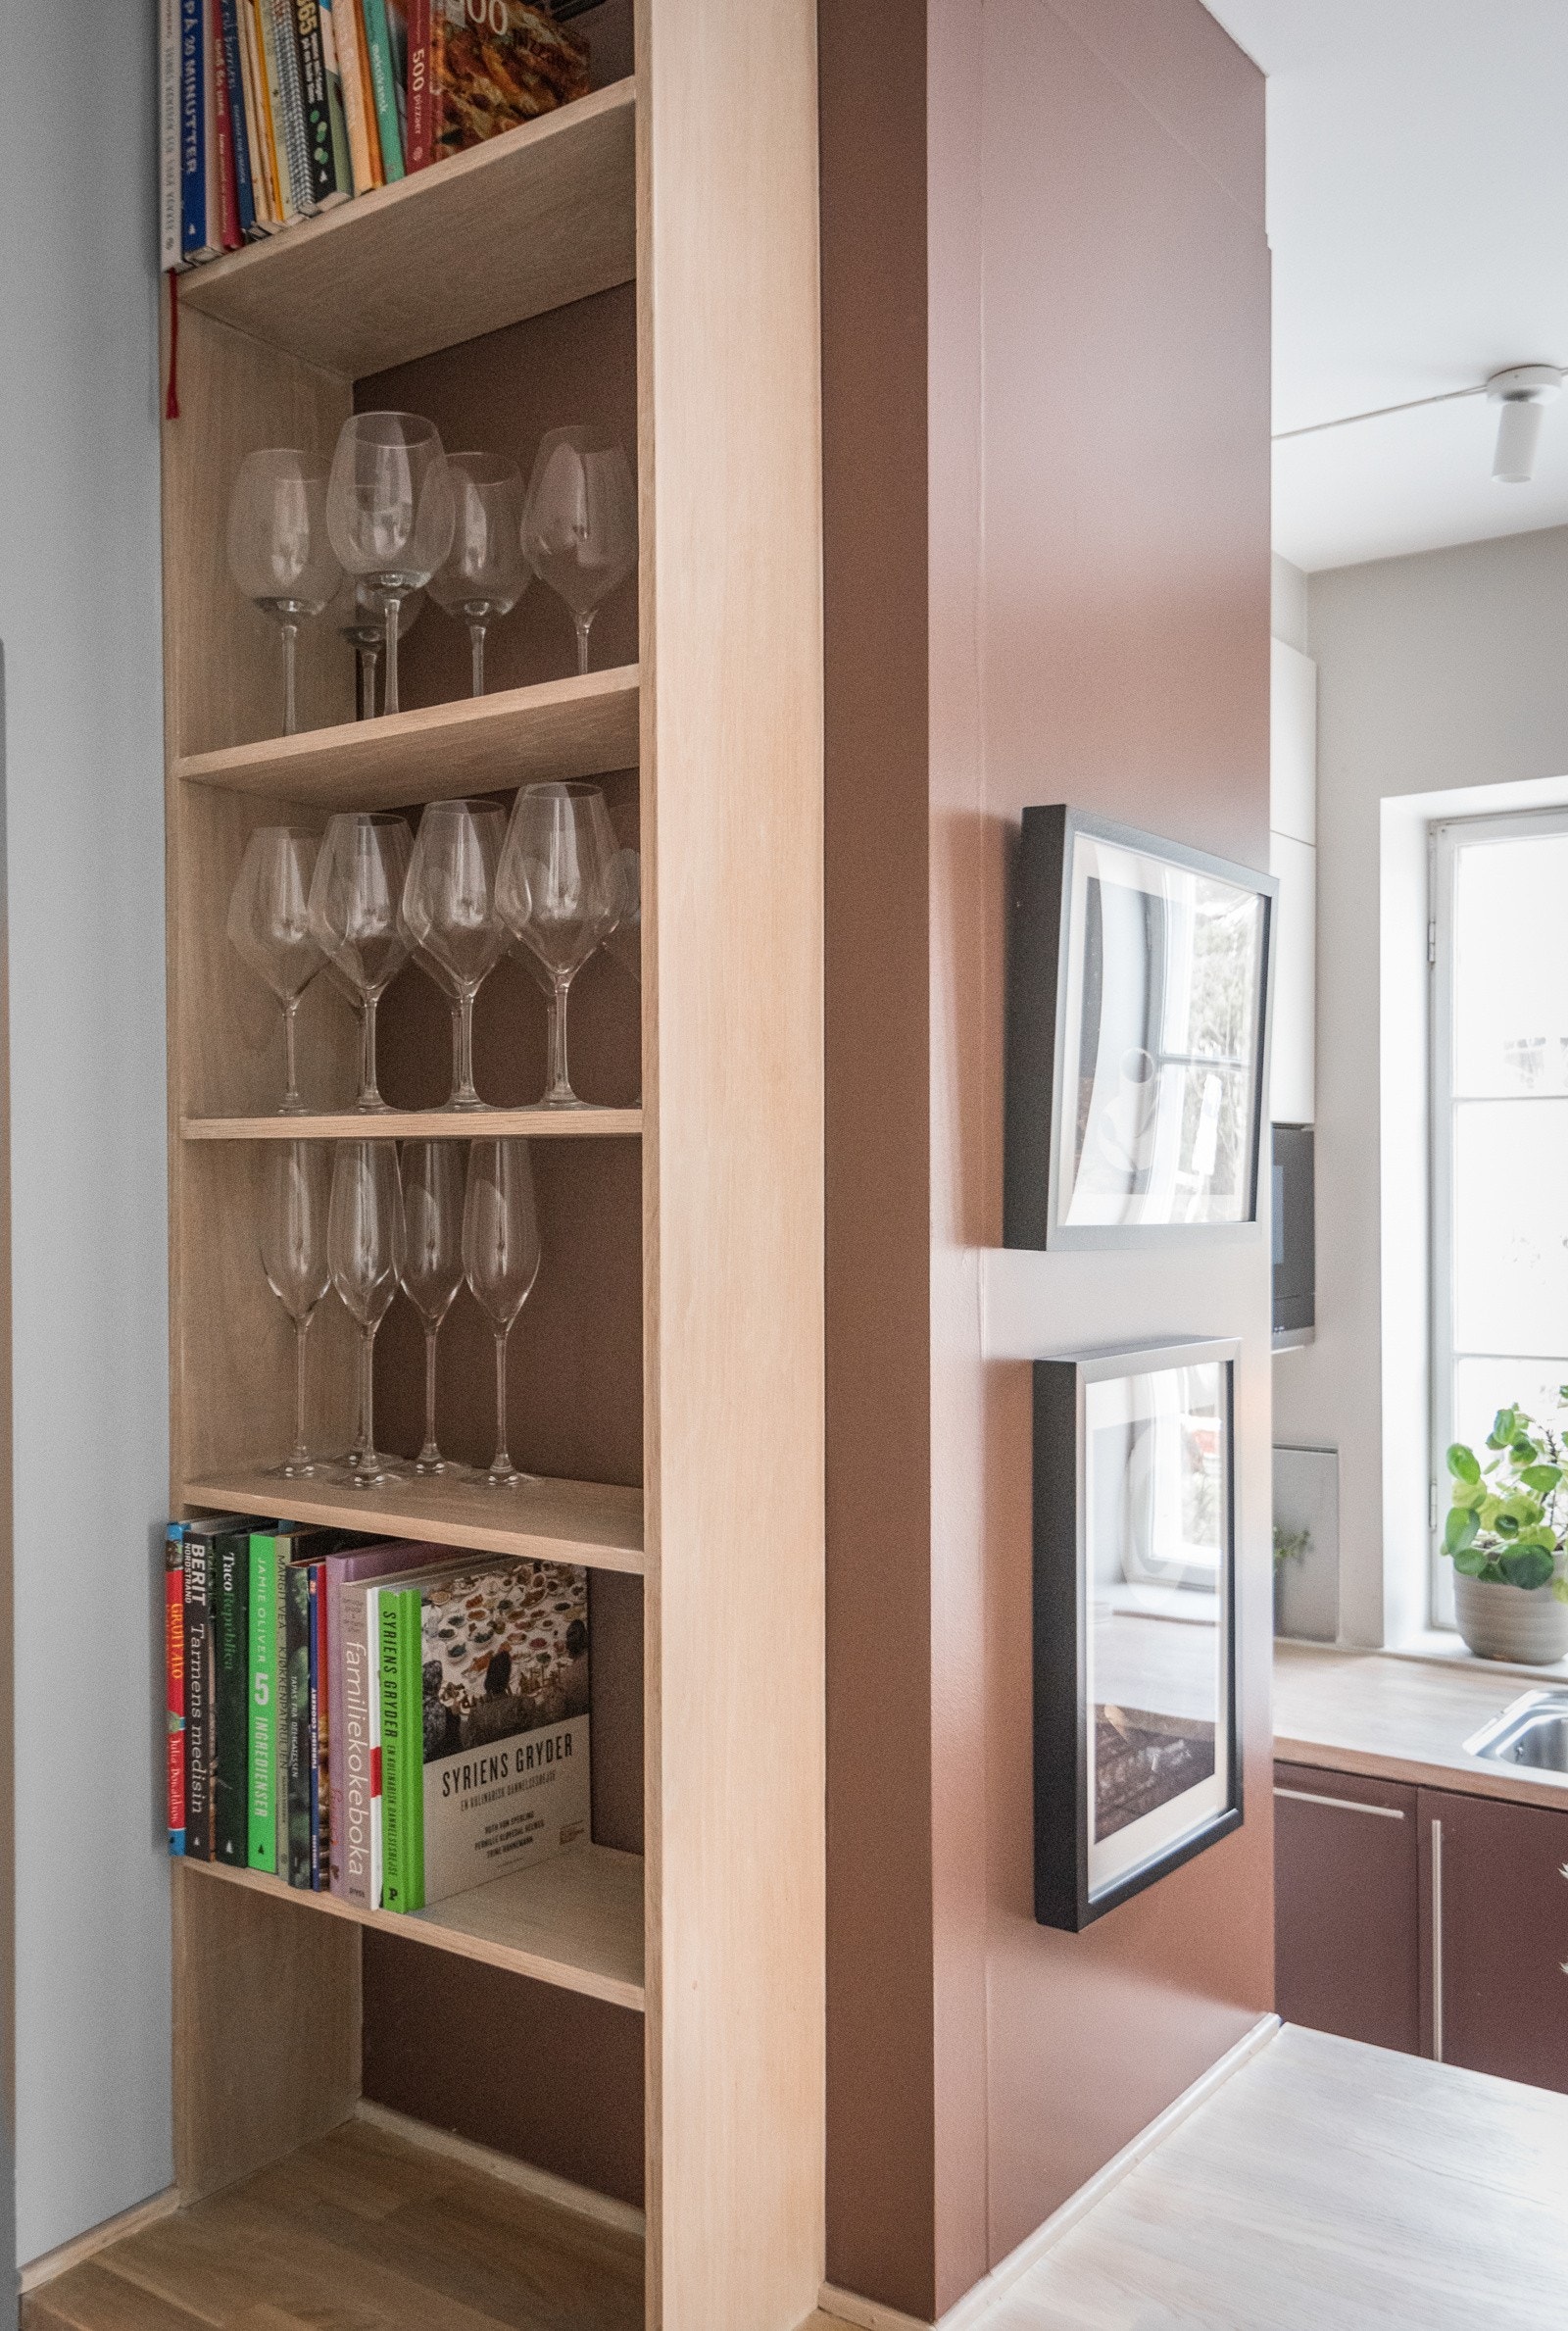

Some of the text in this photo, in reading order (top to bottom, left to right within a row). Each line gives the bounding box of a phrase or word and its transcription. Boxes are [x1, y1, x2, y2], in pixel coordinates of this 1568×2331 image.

[184, 35, 196, 56] 20
[413, 48, 425, 92] 500
[184, 59, 197, 174] MINUTTER
[414, 94, 422, 135] pizzaer
[191, 1544, 206, 1606] BERIT
[222, 1552, 236, 1592] Taco
[277, 1555, 286, 1600] MARGIT
[277, 1605, 286, 1629] VEA
[383, 1612, 398, 1674] SYRIENS
[254, 1557, 270, 1817] JAMIE OLIVER 5 INGREDIENSER
[278, 1646, 288, 1769] KJØKKENPATRULJEN
[383, 1680, 398, 1738] GRYDER
[190, 1622, 207, 1813] Tarmens medisin
[347, 1641, 368, 1875] familiekokeboka
[387, 1744, 396, 1755] EN
[442, 1733, 572, 1797] SYRIENS GRYDER
[170, 1738, 182, 1823] Julia Donaldson
[387, 1757, 396, 1805] KULINARISK
